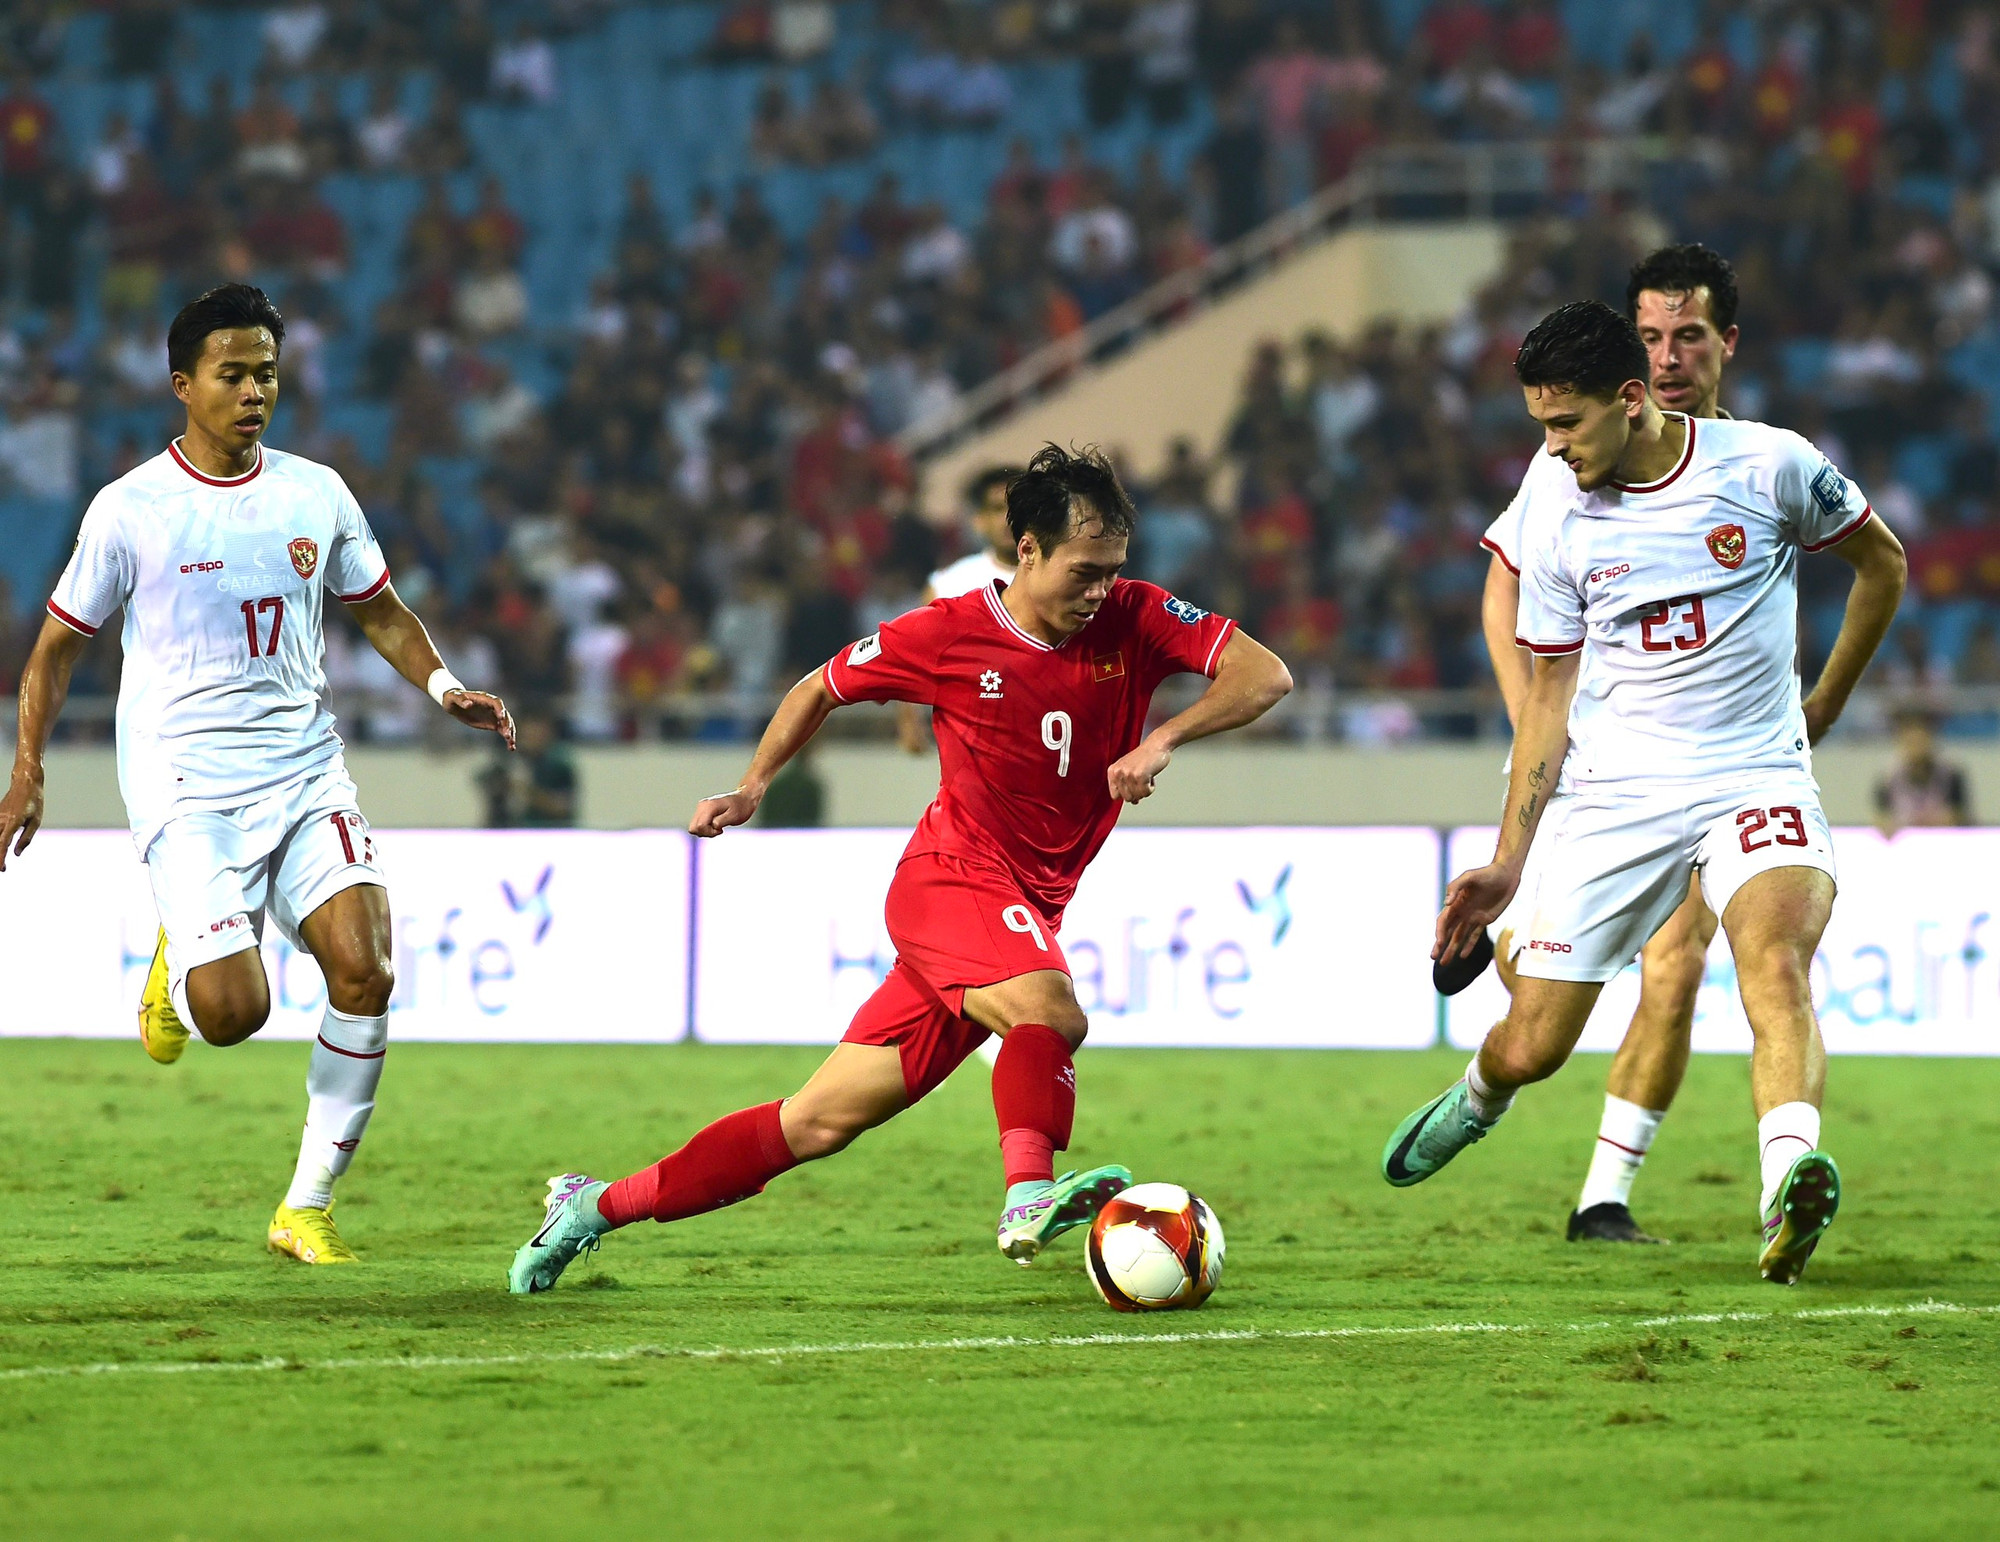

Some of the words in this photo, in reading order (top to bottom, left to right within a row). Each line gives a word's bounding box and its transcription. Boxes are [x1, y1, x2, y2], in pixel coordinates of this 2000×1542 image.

[180, 560, 224, 573] erspo
[1590, 563, 1630, 583] erspo
[240, 596, 283, 658] 17
[1636, 594, 1707, 652] 23
[1041, 711, 1072, 777] 9
[1736, 806, 1808, 853] 23
[1002, 904, 1049, 952] 9
[1530, 940, 1572, 953] erspo
